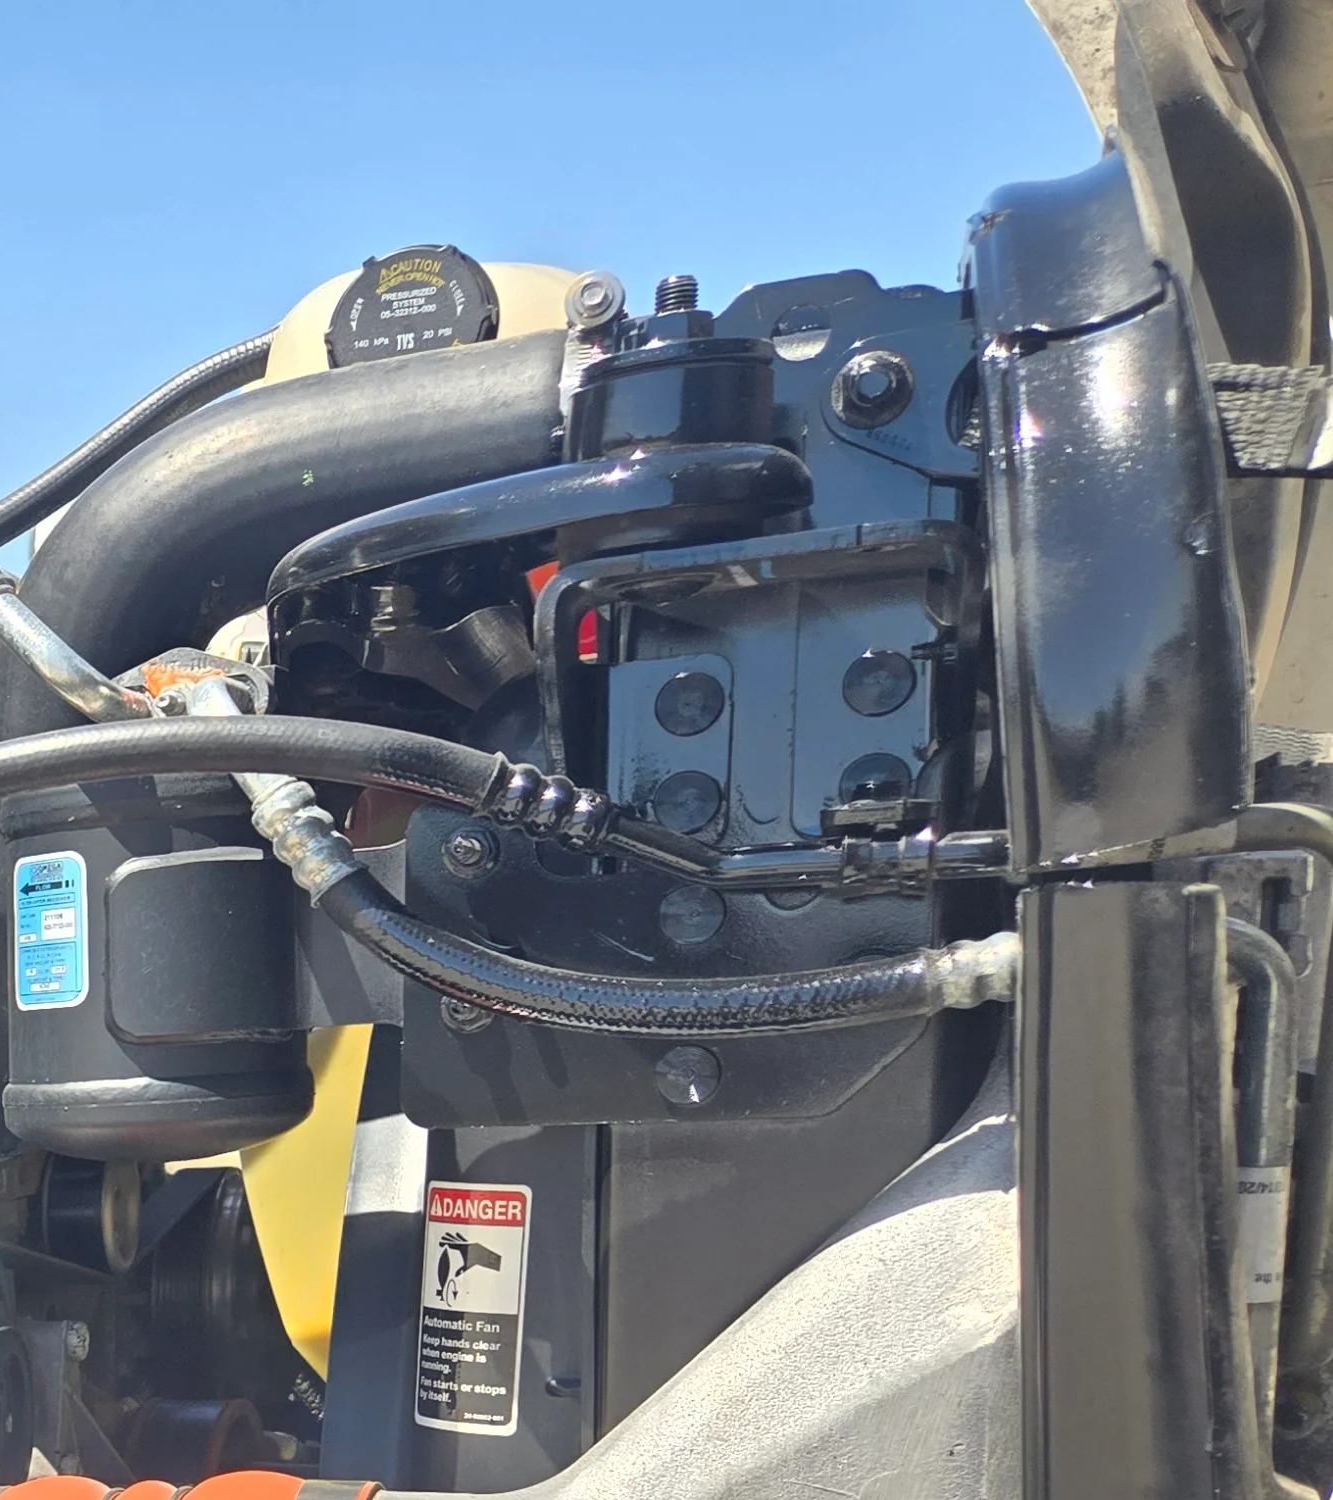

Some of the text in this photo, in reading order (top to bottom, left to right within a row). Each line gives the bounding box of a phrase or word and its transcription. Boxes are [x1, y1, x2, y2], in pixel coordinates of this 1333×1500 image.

[390, 258, 441, 277] CAUTION
[381, 287, 437, 302] PRESSURIZED
[392, 297, 425, 309] SYSTEM
[396, 333, 415, 351] TVS
[422, 327, 453, 340] 20 PSI
[443, 1197, 522, 1220] DANGER
[424, 1315, 500, 1333] Automatic Fan
[423, 1333, 501, 1351] Keep hands clear
[422, 1347, 487, 1363] when engine is
[421, 1360, 452, 1375] running.
[420, 1375, 507, 1397] Fan starts or stops
[419, 1389, 452, 1403] by itself.
